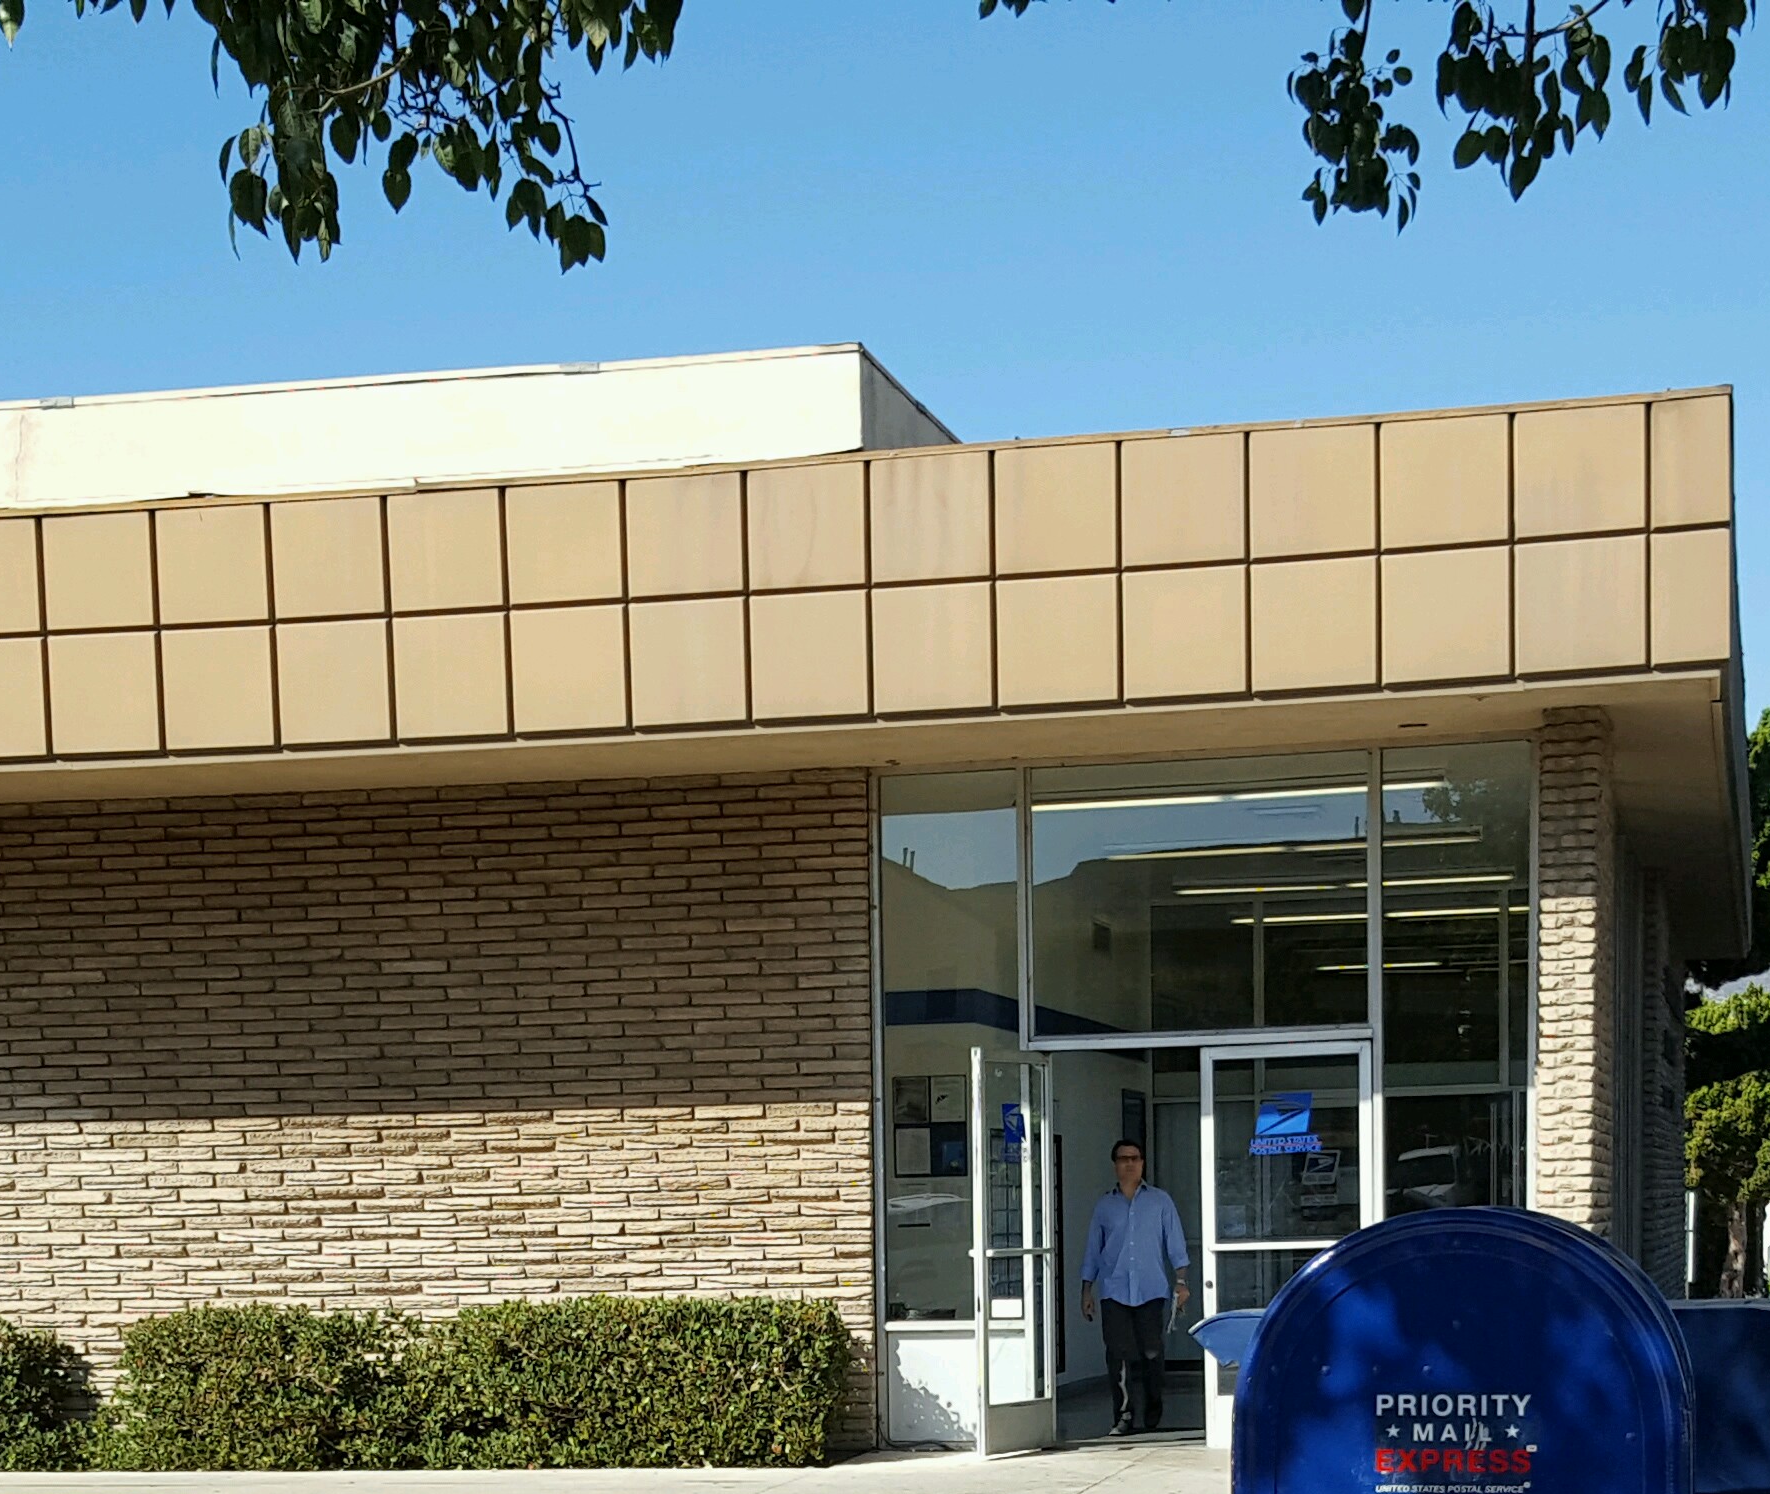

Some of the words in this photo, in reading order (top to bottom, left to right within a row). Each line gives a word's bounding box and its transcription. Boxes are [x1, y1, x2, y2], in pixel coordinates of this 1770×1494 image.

[1250, 1137, 1285, 1147] UNITED
[1286, 1135, 1320, 1144] STATES
[1249, 1146, 1282, 1155] POSTAL
[1284, 1144, 1322, 1153] SERVICE
[1376, 1393, 1531, 1417] PRIORITY
[1413, 1423, 1492, 1442] MAIL
[1374, 1448, 1532, 1473] EXPRESS
[1375, 1484, 1410, 1494] UNITED
[1412, 1484, 1446, 1494] STATES
[1447, 1485, 1483, 1494] POSTAL
